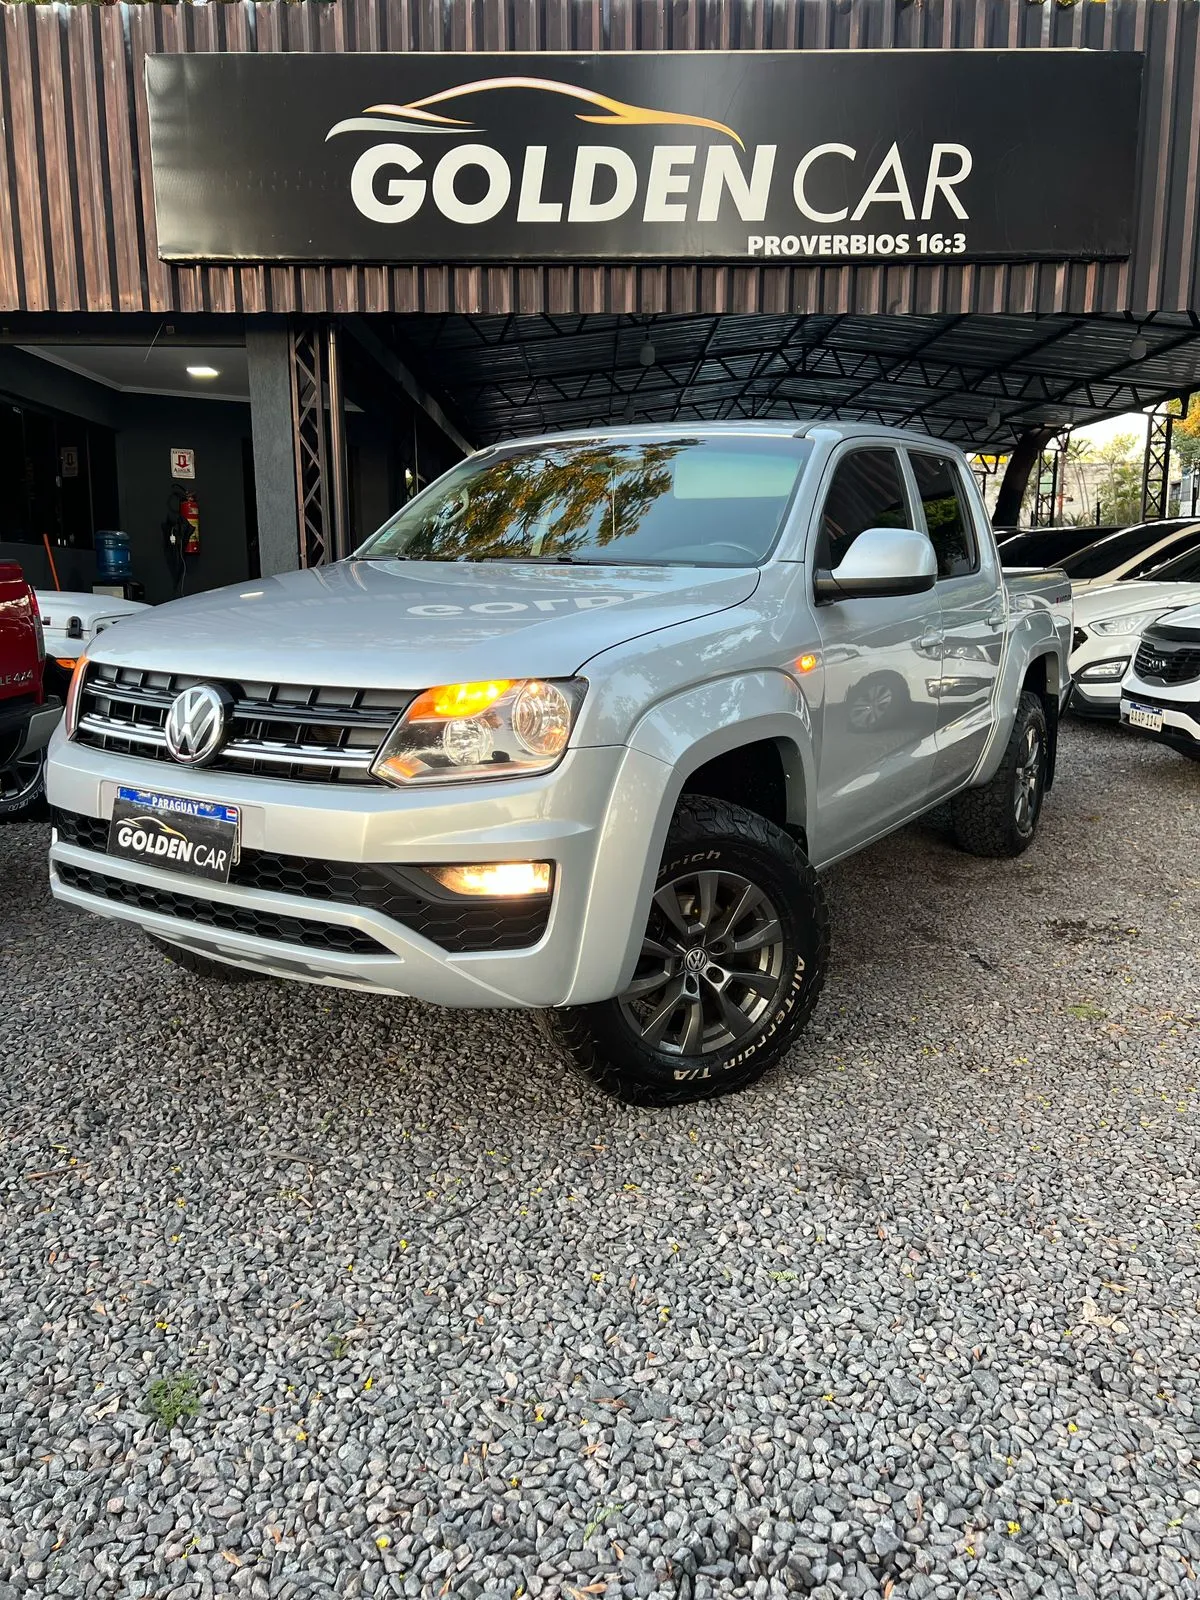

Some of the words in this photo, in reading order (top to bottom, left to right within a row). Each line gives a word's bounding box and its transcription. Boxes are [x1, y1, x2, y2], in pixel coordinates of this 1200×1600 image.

[350, 143, 778, 224] GOLDEN
[792, 141, 973, 223] CAR
[747, 234, 911, 255] PROVERBIOS
[915, 232, 967, 255] 16:3
[151, 796, 200, 815] PARAGUAY
[117, 827, 193, 862] GOLDEN
[193, 844, 227, 872] CAR
[723, 954, 806, 1071] All-Terrain
[673, 1066, 712, 1082] T/A
